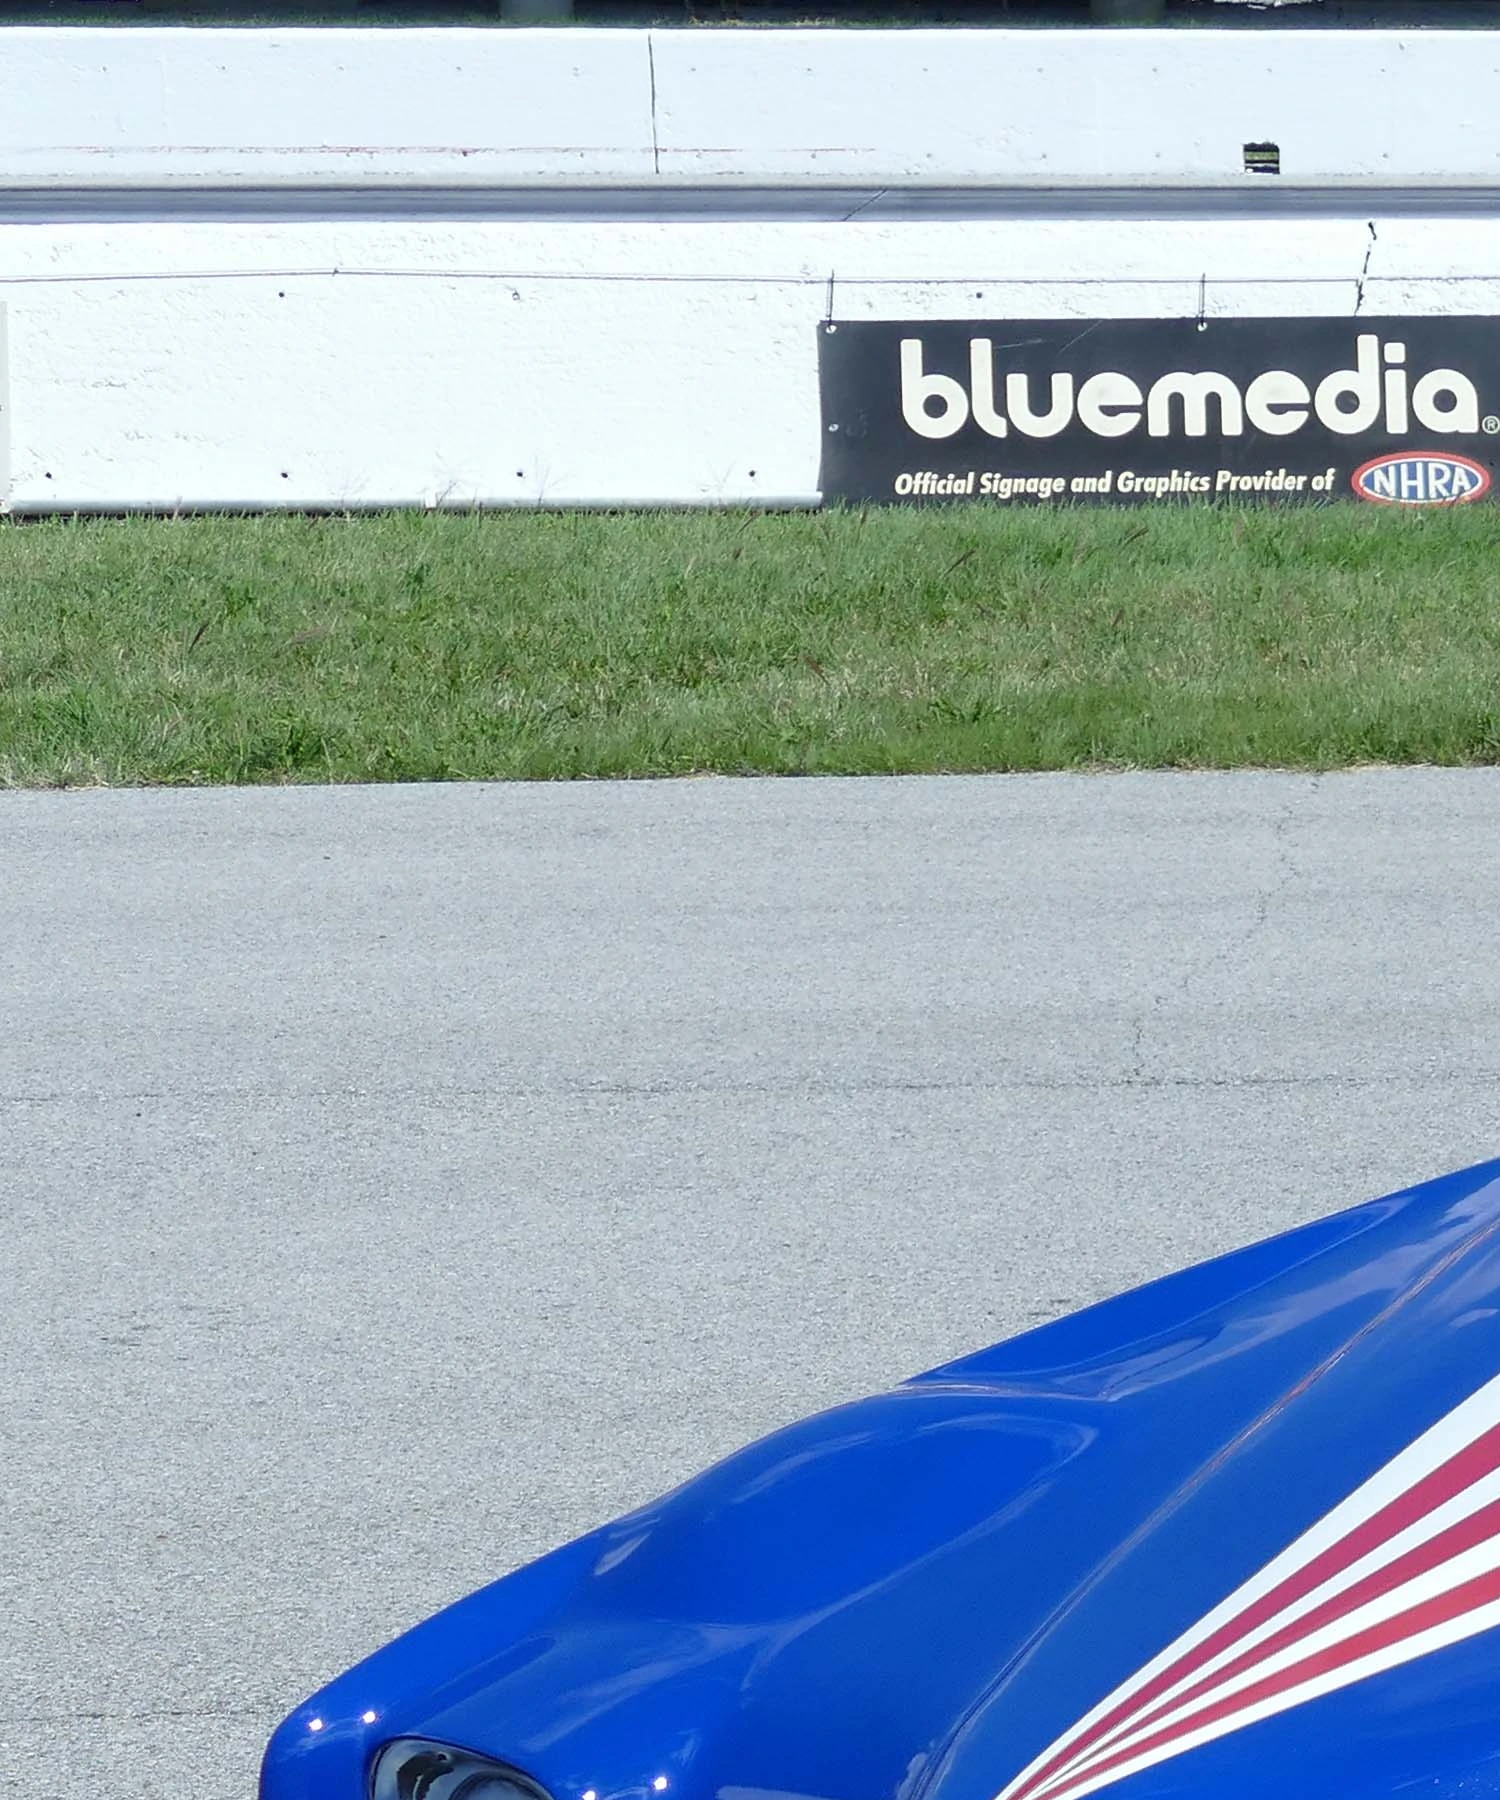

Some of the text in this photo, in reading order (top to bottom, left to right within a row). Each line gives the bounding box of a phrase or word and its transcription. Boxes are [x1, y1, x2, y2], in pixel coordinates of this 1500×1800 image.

[895, 461, 1473, 499] Official Signage and Graphics Provider of NHRA
